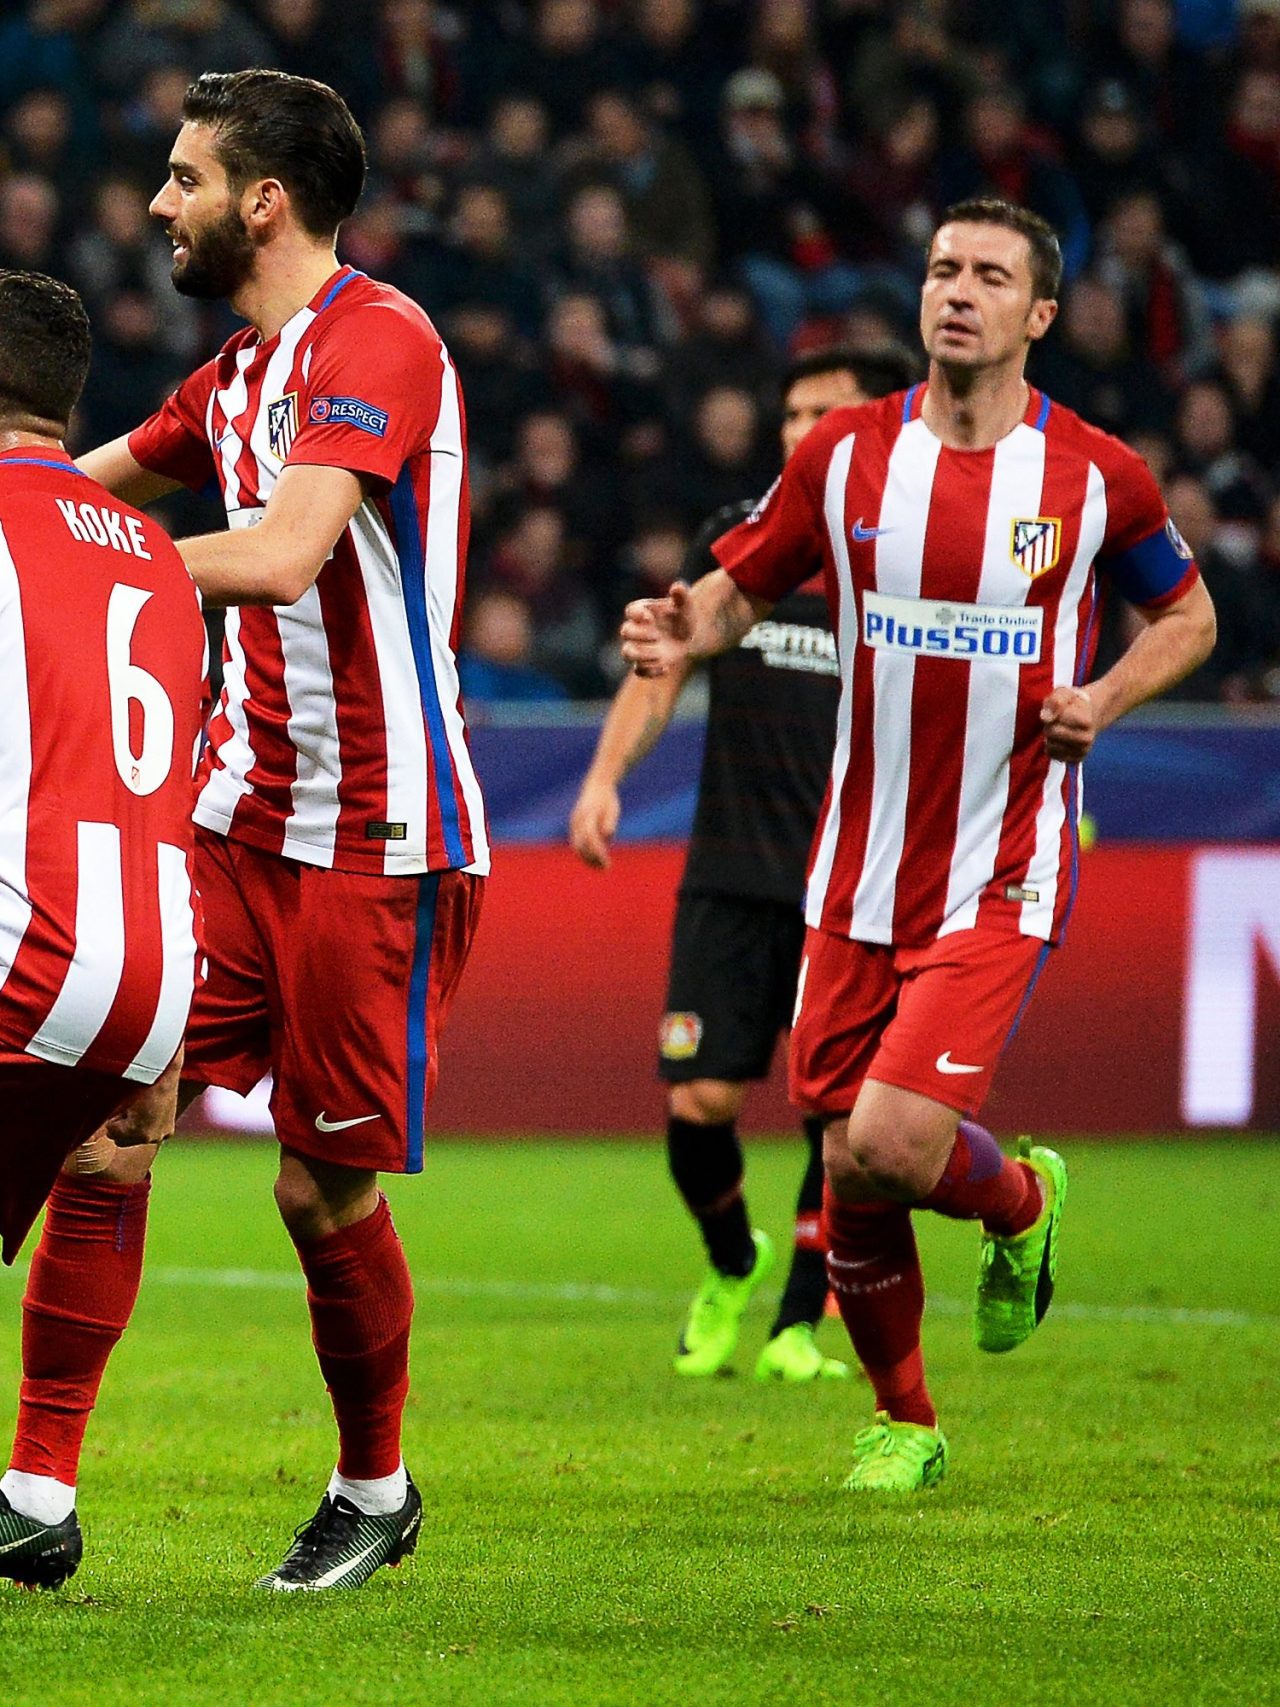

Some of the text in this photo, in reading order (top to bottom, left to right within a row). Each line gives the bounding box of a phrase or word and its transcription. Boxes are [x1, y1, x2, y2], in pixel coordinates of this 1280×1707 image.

[331, 403, 387, 430] RESPECT
[54, 498, 153, 561] KOKE
[867, 611, 1038, 657] Plus500
[959, 612, 996, 625] Trade
[105, 582, 176, 797] 6
